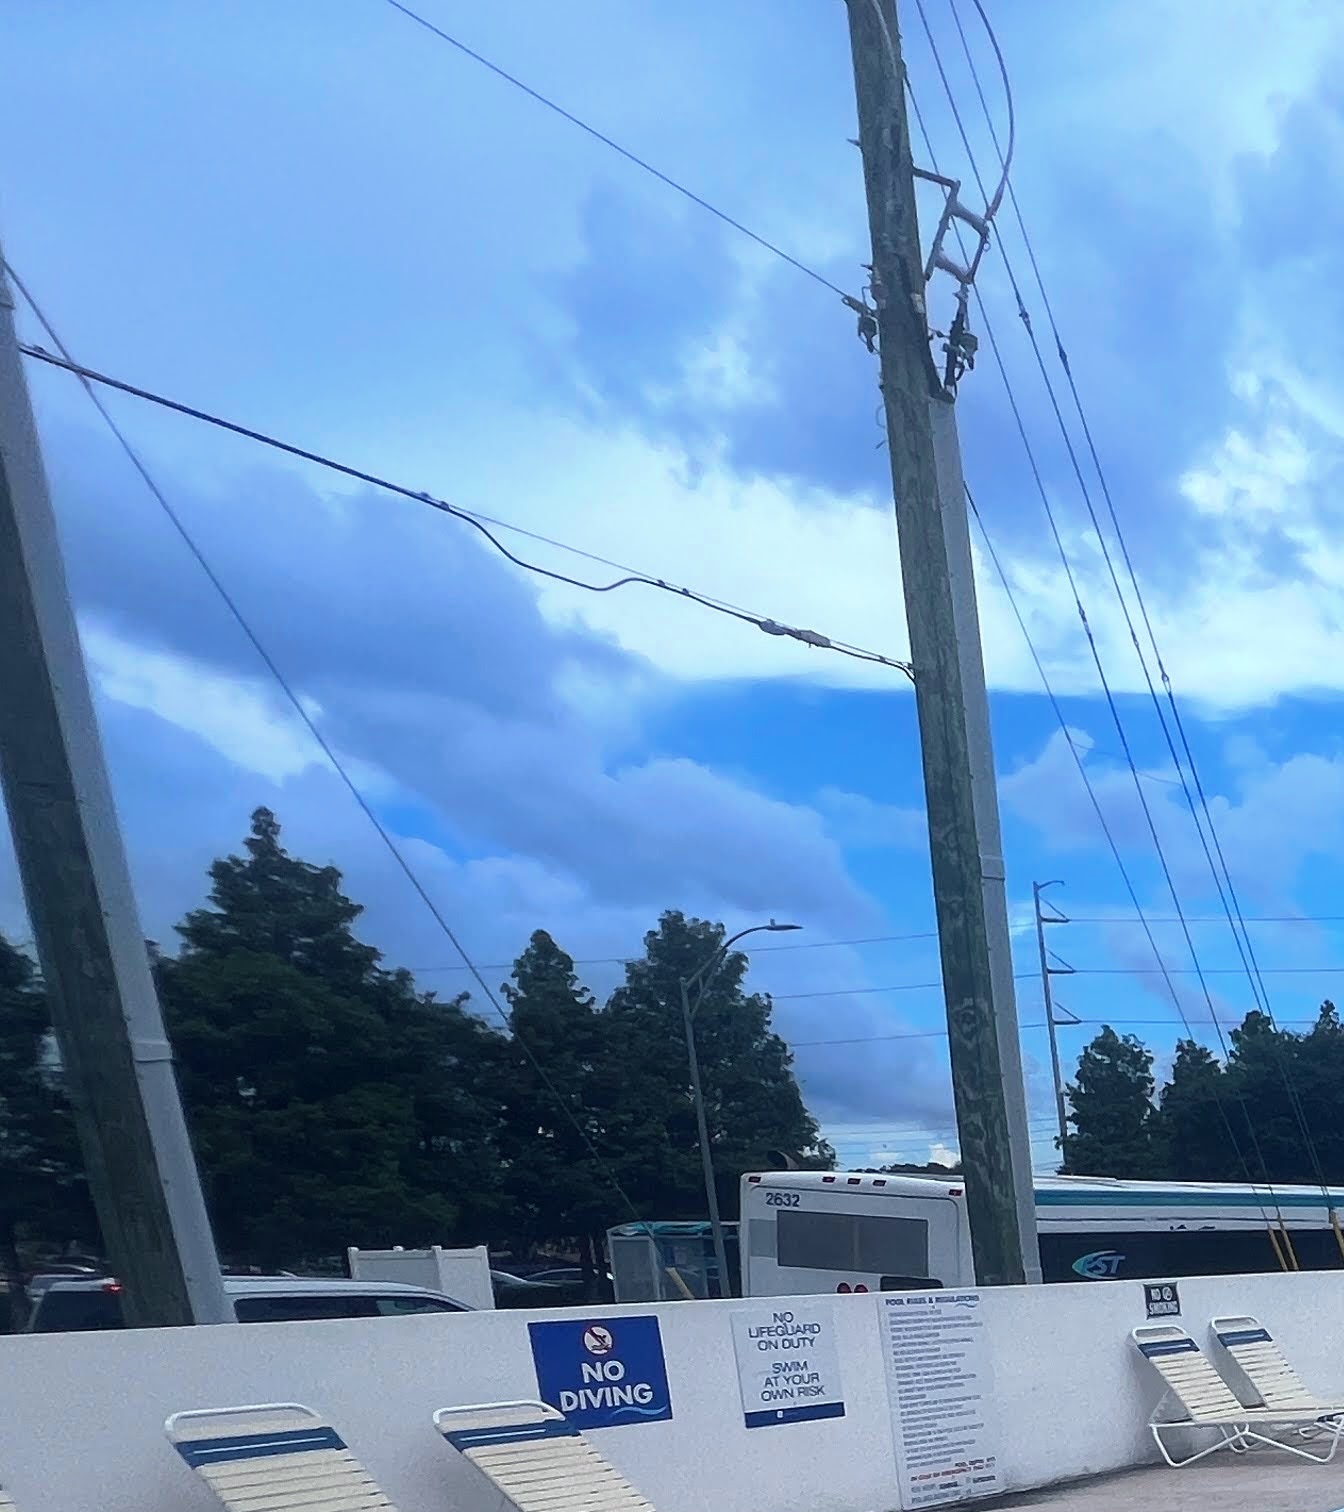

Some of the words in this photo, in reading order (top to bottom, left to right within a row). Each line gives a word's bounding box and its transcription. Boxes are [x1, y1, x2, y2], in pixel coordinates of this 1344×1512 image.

[765, 1192, 801, 1207] 2632
[772, 1311, 795, 1323] NO
[748, 1322, 821, 1338] LIFEGUARD
[757, 1340, 779, 1351] ON
[781, 1336, 816, 1350] DUTY
[581, 1360, 625, 1383] NO
[772, 1360, 808, 1374] SWIM
[764, 1376, 780, 1388] AT
[782, 1372, 820, 1386] YOUR
[559, 1383, 653, 1412] DIVING
[760, 1388, 795, 1402] OWN
[797, 1385, 826, 1398] RISK
